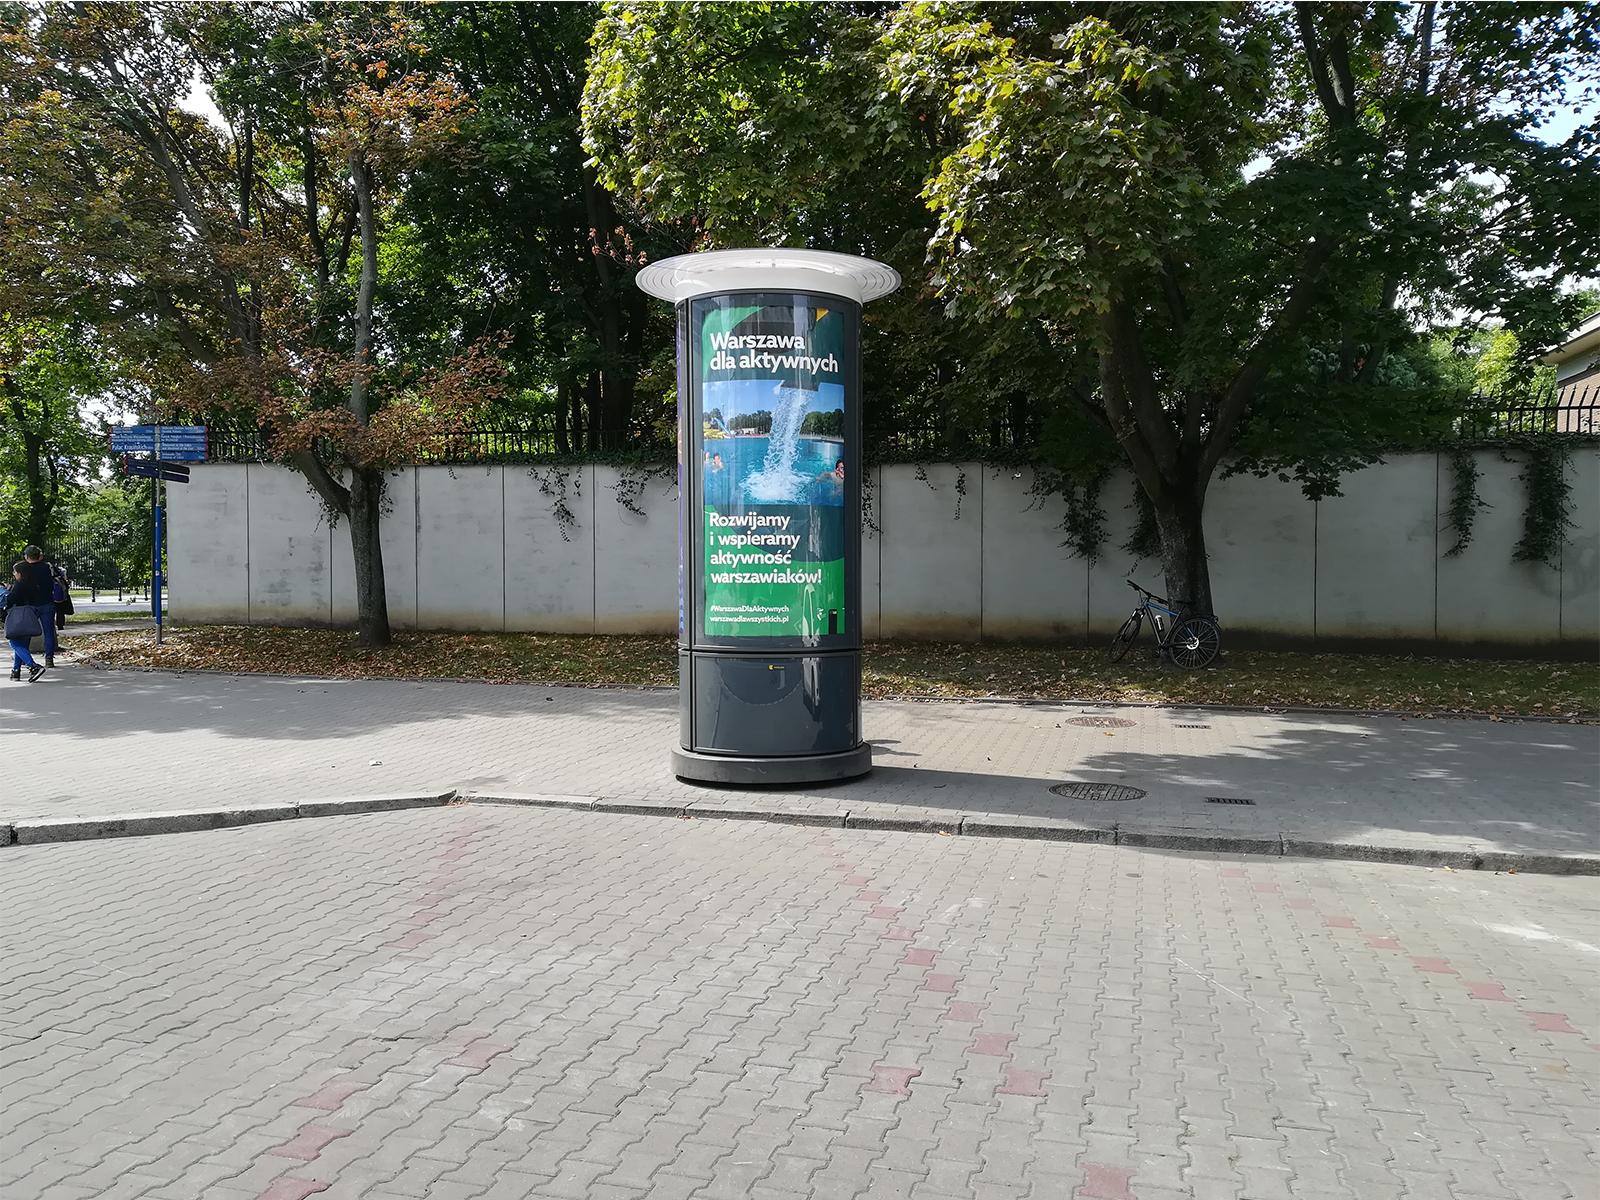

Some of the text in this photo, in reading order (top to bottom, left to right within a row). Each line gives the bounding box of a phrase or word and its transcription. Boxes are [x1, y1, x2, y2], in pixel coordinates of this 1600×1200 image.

[709, 331, 805, 350] Warszawa
[709, 349, 839, 375] dla aktywnych
[709, 511, 791, 530] Rozwijamy
[709, 530, 801, 549] i wspieramy
[710, 549, 792, 568] aktywność
[710, 568, 822, 584] warszawiaków!
[710, 605, 790, 614] #WarszawaDlaAktywnych
